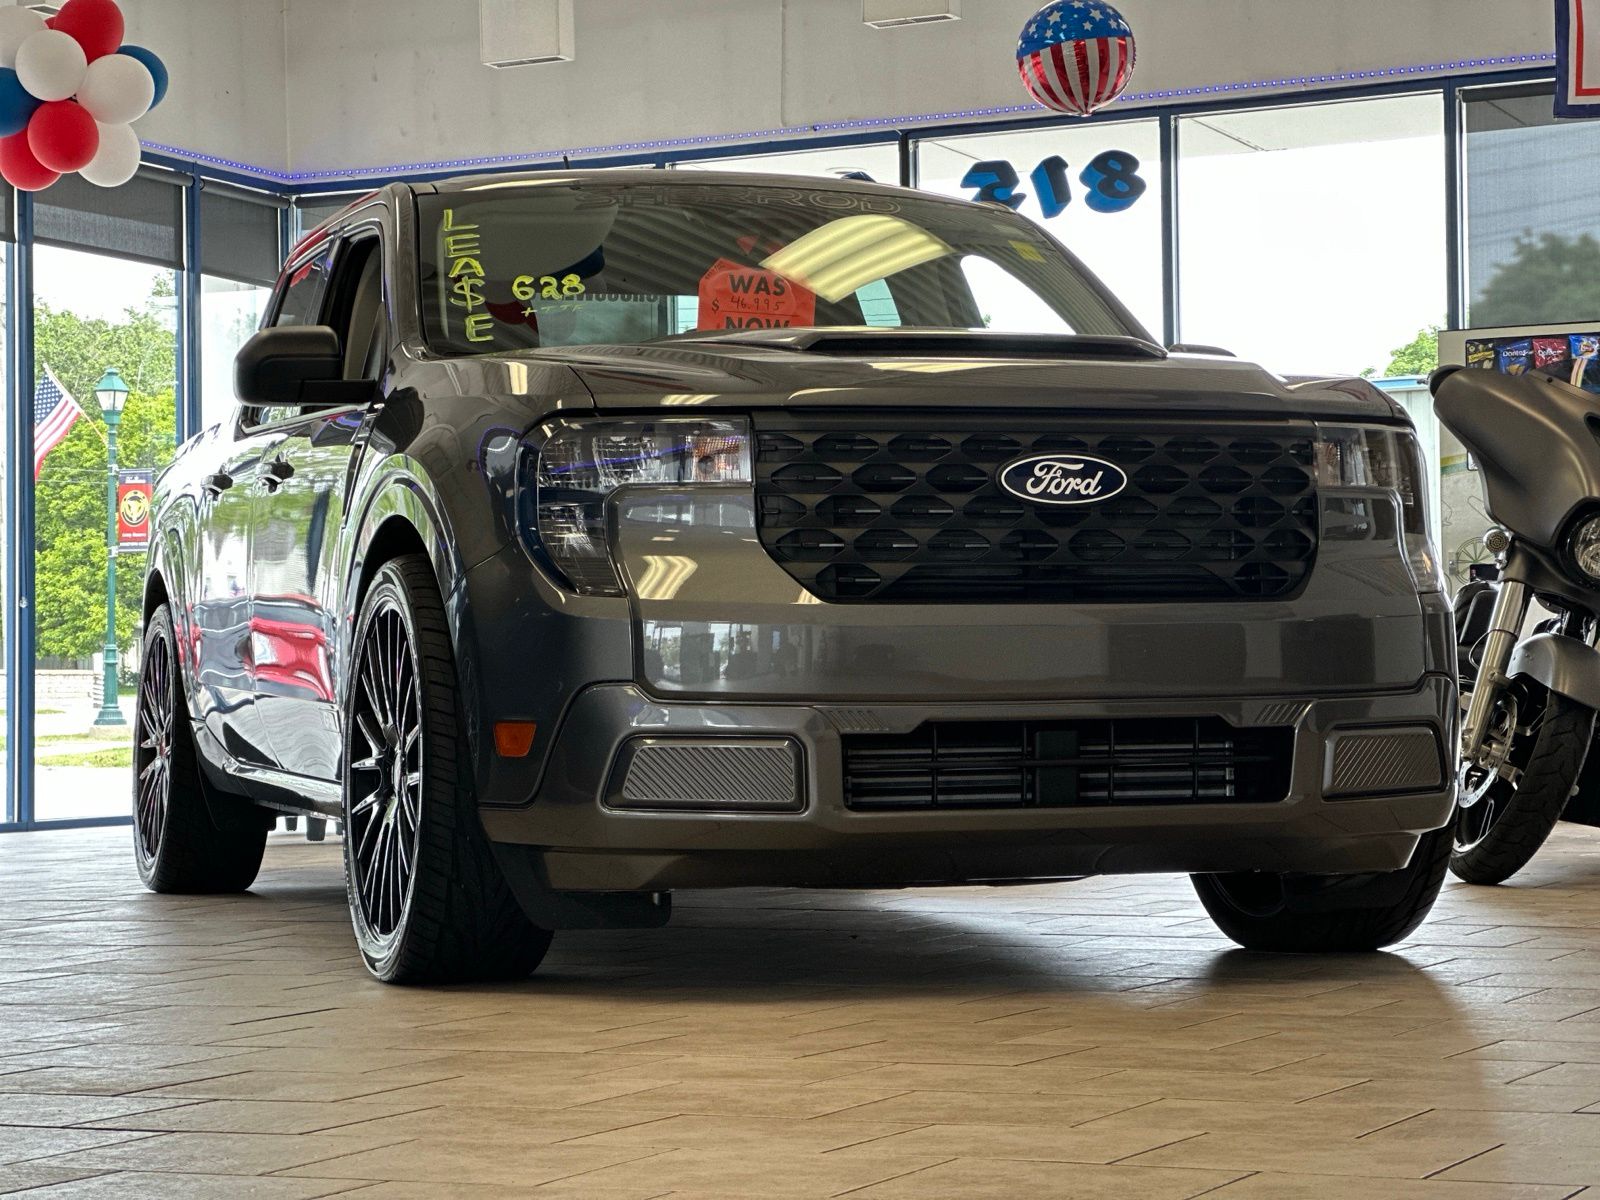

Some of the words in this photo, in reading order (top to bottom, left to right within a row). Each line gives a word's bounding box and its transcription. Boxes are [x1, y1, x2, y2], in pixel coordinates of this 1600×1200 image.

[512, 273, 585, 301] 628
[728, 273, 786, 296] WAS
[711, 297, 720, 314] $
[1026, 461, 1103, 495] Ford
